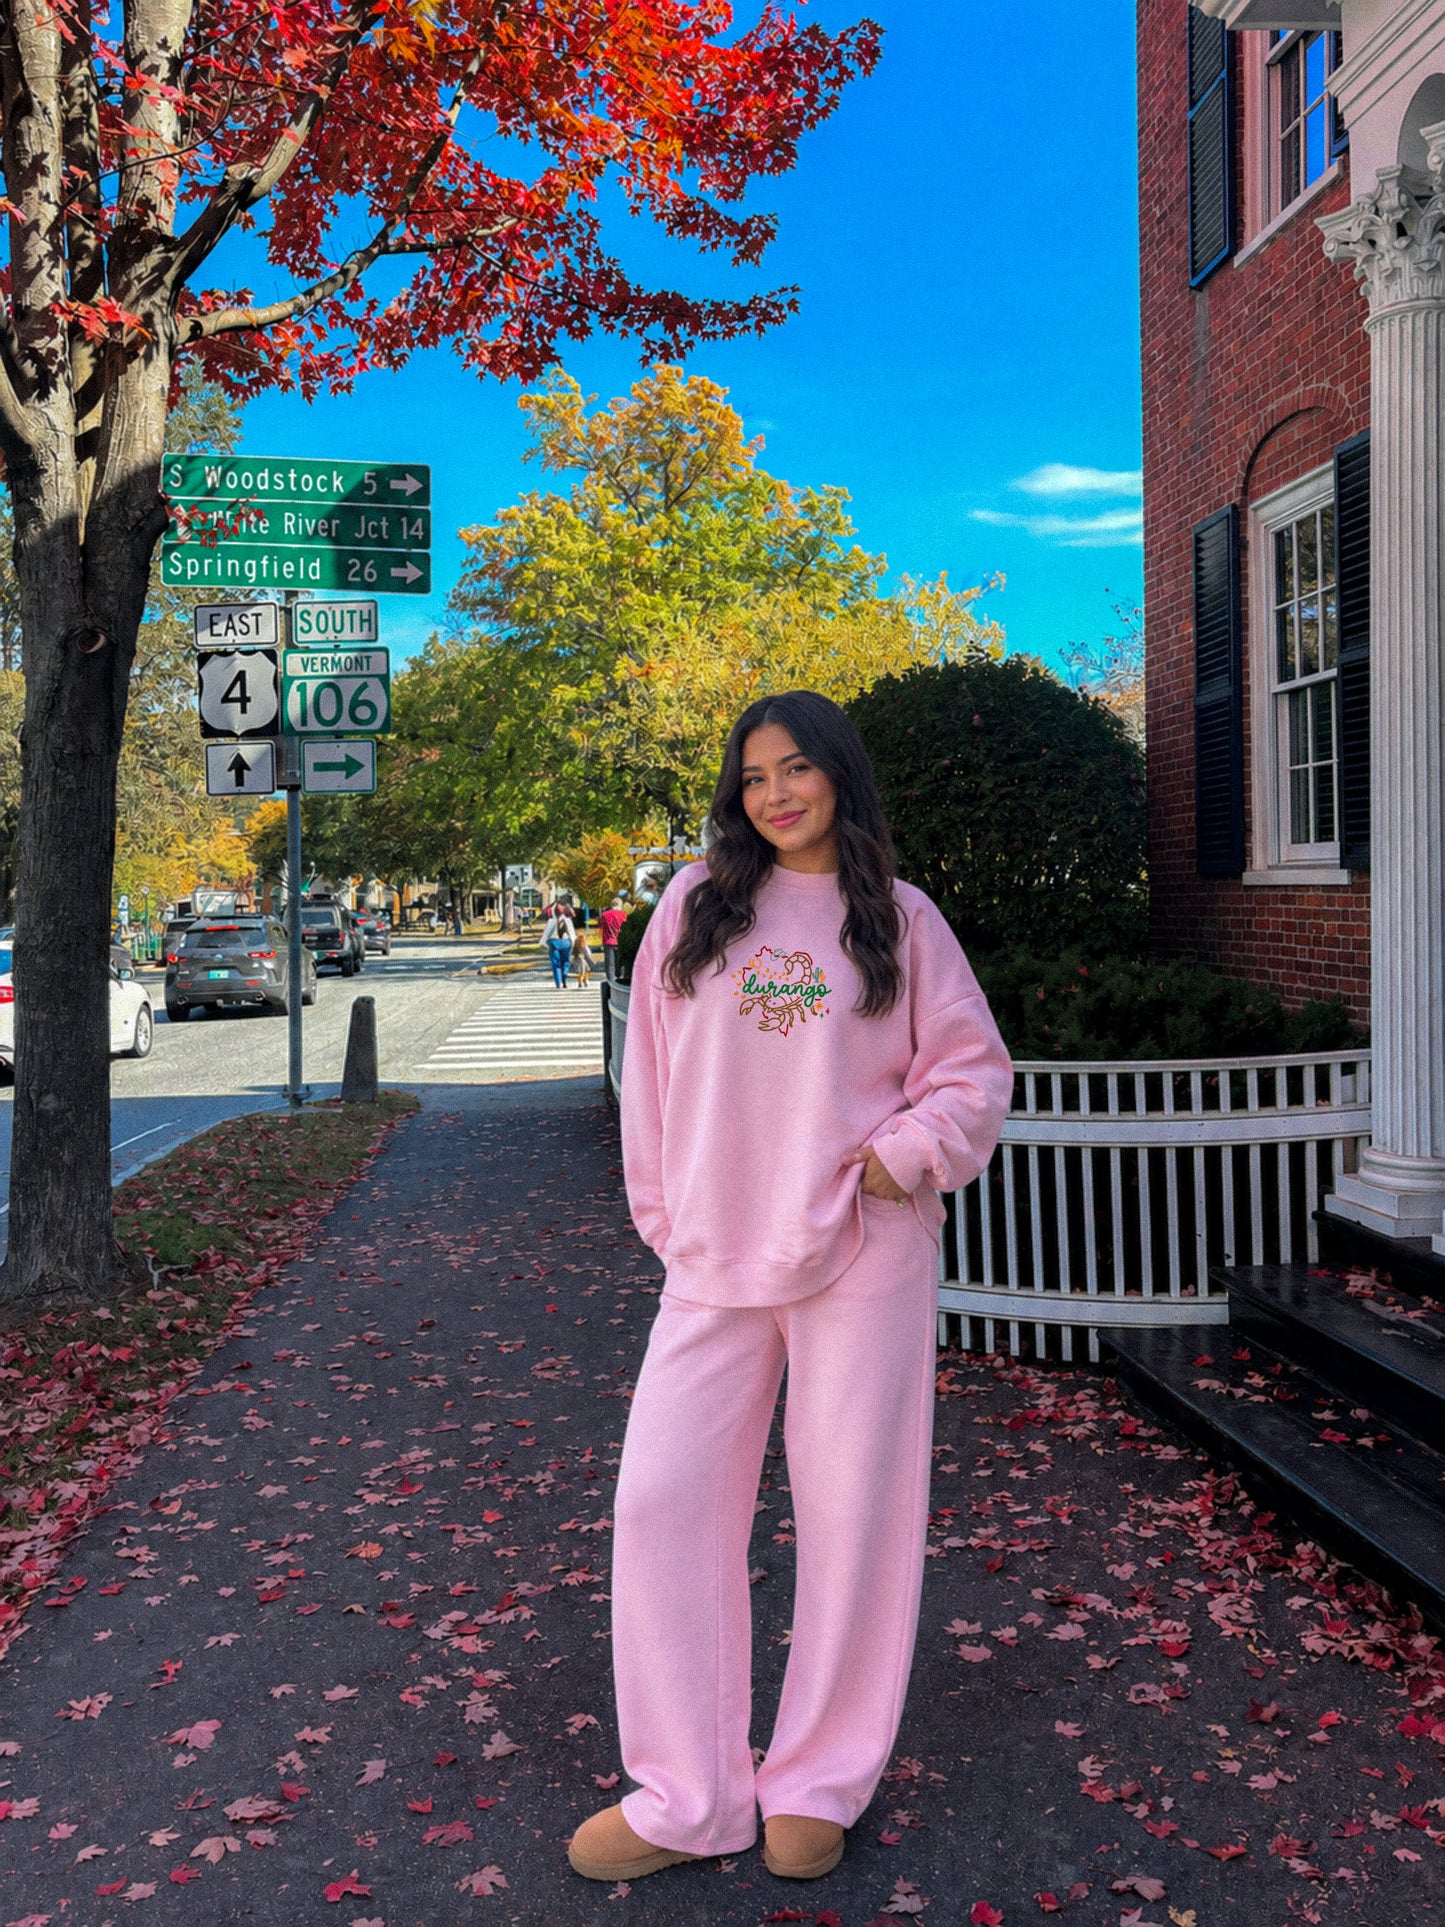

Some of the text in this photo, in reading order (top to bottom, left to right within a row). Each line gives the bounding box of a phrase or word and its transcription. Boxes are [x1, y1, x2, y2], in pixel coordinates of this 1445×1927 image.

[169, 463, 377, 495] S Woodstock 5
[284, 512, 340, 537] River
[354, 515, 389, 539] Jct
[401, 517, 424, 540] 14
[169, 552, 377, 583] Springfield 26
[209, 613, 262, 637] EAST
[299, 609, 372, 634] SOUTH
[301, 655, 372, 673] VERMONT
[220, 670, 251, 714] 4
[296, 681, 378, 727] 106
[742, 973, 832, 1008] durango
